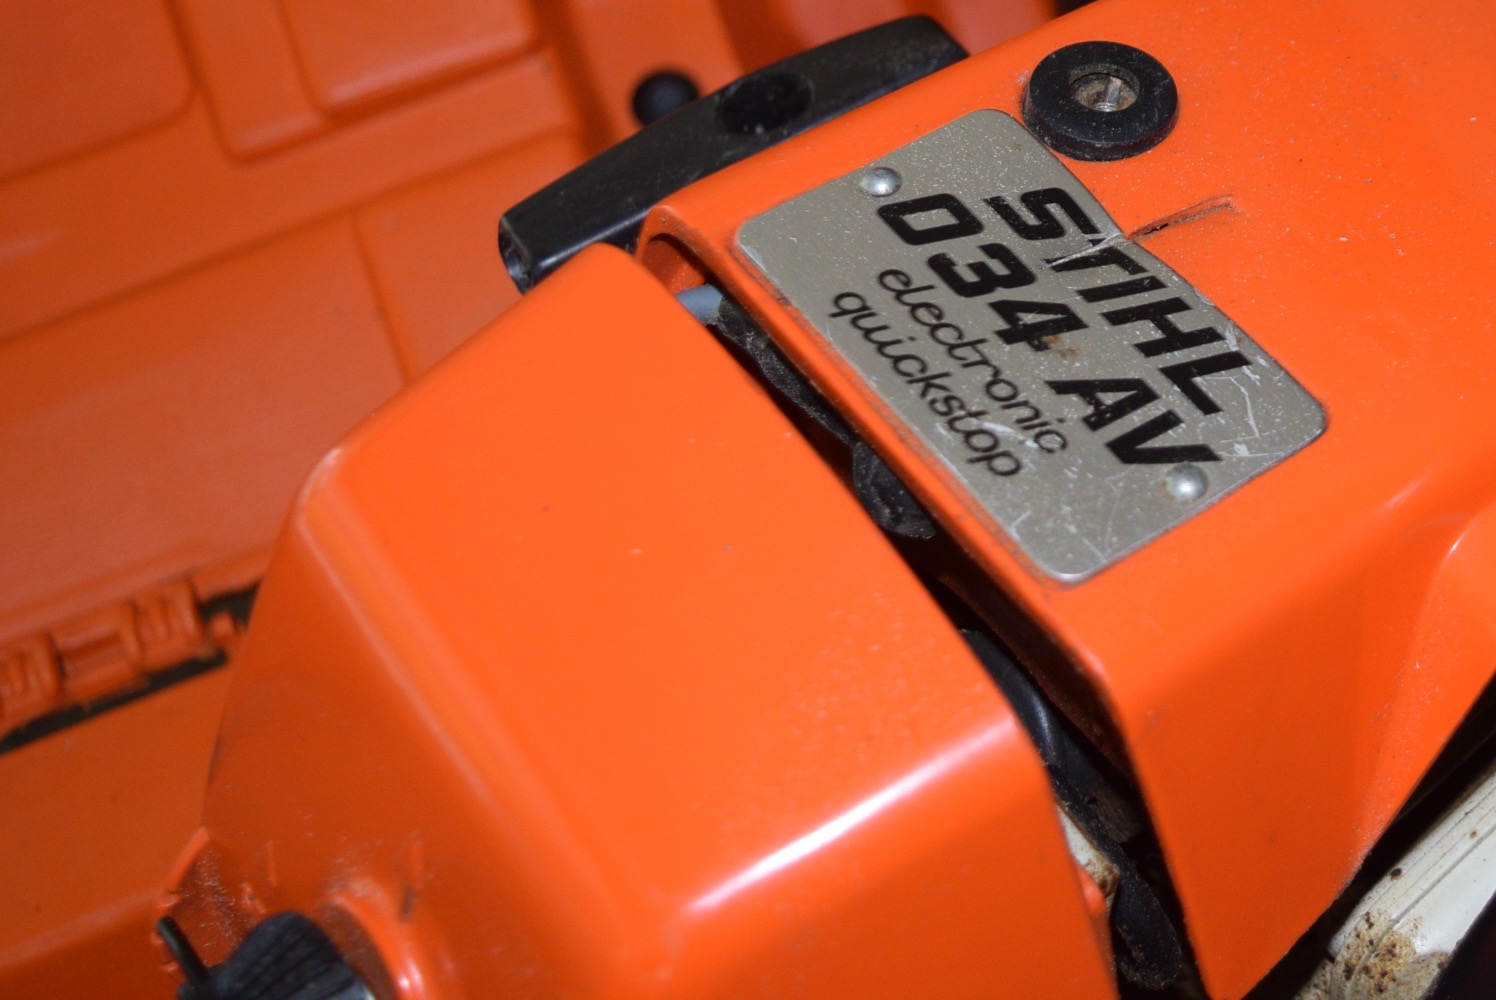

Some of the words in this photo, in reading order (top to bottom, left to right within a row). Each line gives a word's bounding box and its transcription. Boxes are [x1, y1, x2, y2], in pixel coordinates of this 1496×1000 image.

[827, 290, 1022, 478] quickstop
[876, 192, 1090, 352] 034
[1043, 377, 1223, 465] AV
[877, 267, 1069, 454] electronic
[983, 186, 1252, 416] STIHL
